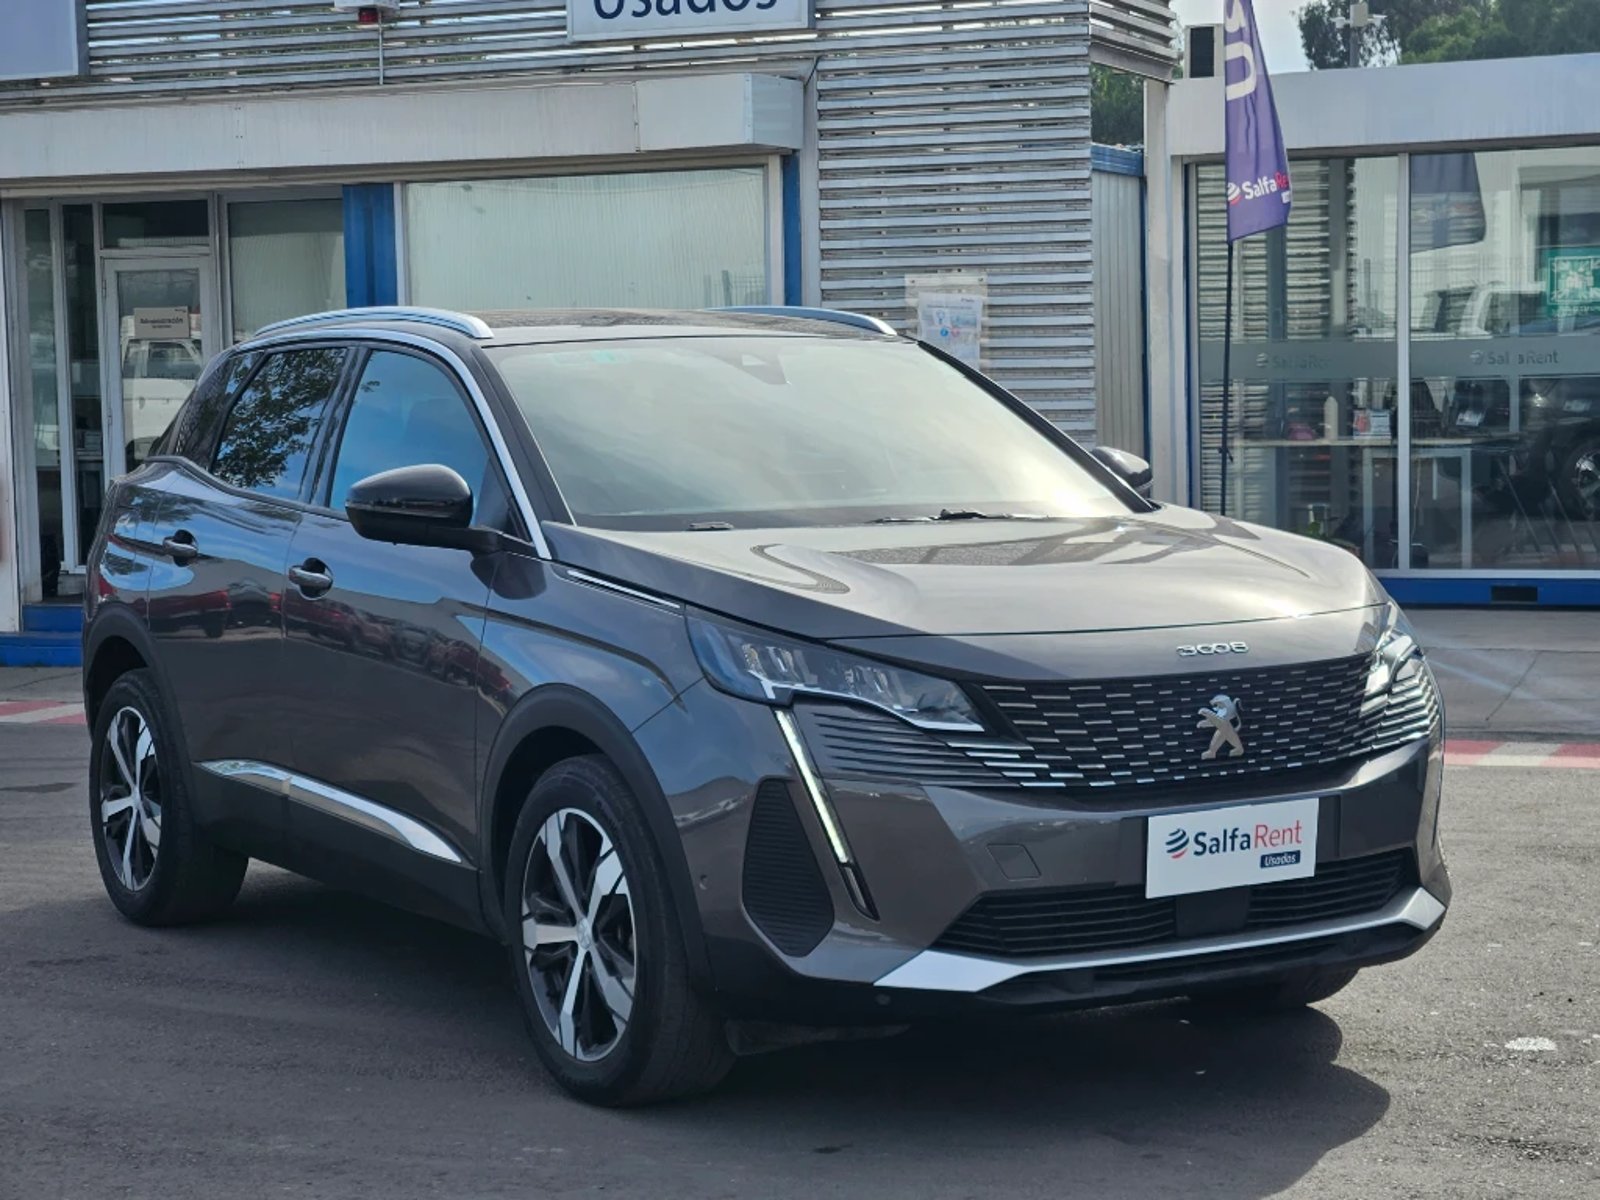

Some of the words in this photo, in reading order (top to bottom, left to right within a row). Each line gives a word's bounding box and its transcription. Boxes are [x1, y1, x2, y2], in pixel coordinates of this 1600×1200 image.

[1487, 349, 1559, 365] SalaRent
[1176, 641, 1249, 656] 3008
[1193, 820, 1302, 856] SalfaRent
[1264, 852, 1297, 867] Usados
